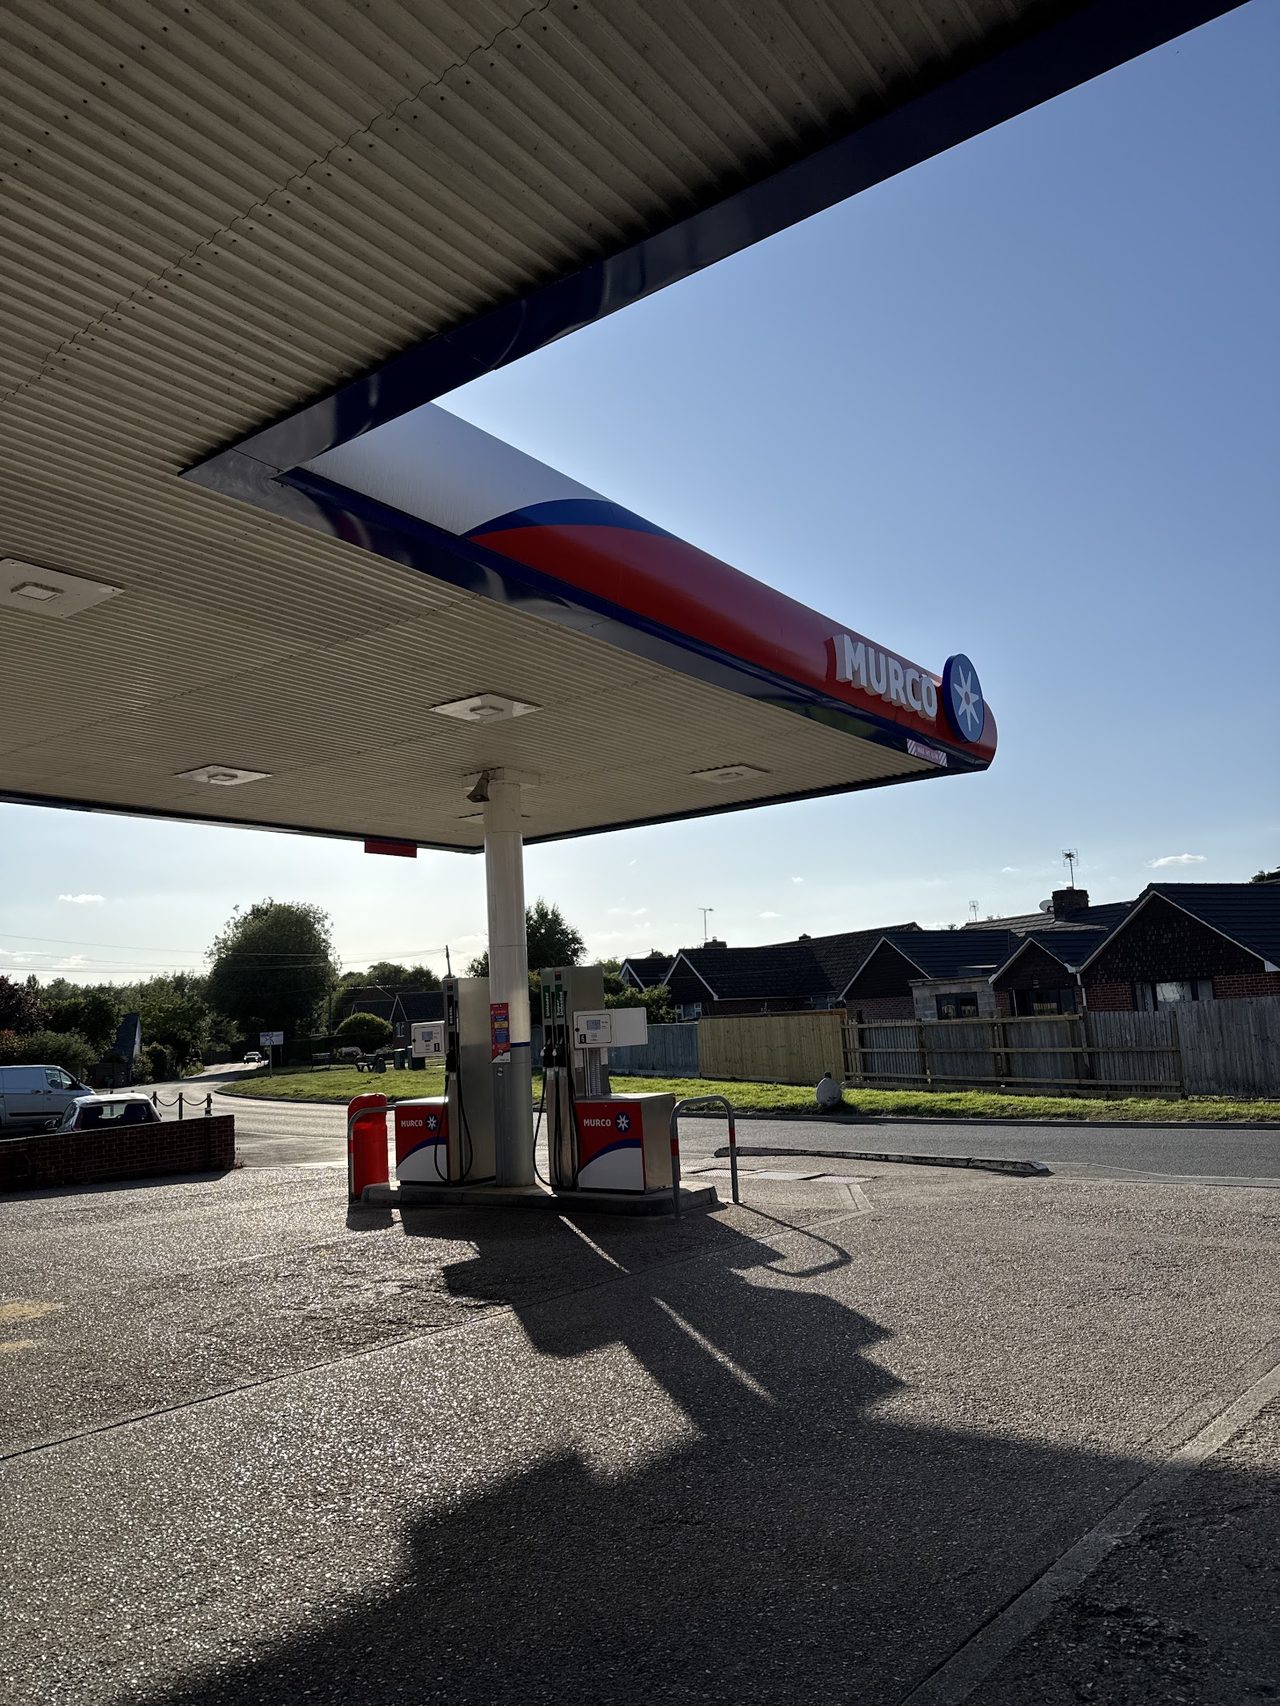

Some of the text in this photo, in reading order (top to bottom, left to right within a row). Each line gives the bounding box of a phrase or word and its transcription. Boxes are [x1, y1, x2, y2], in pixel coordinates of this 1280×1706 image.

[839, 633, 938, 718] MURCO
[400, 1119, 423, 1128] MURCO
[583, 1118, 612, 1127] MURCO
